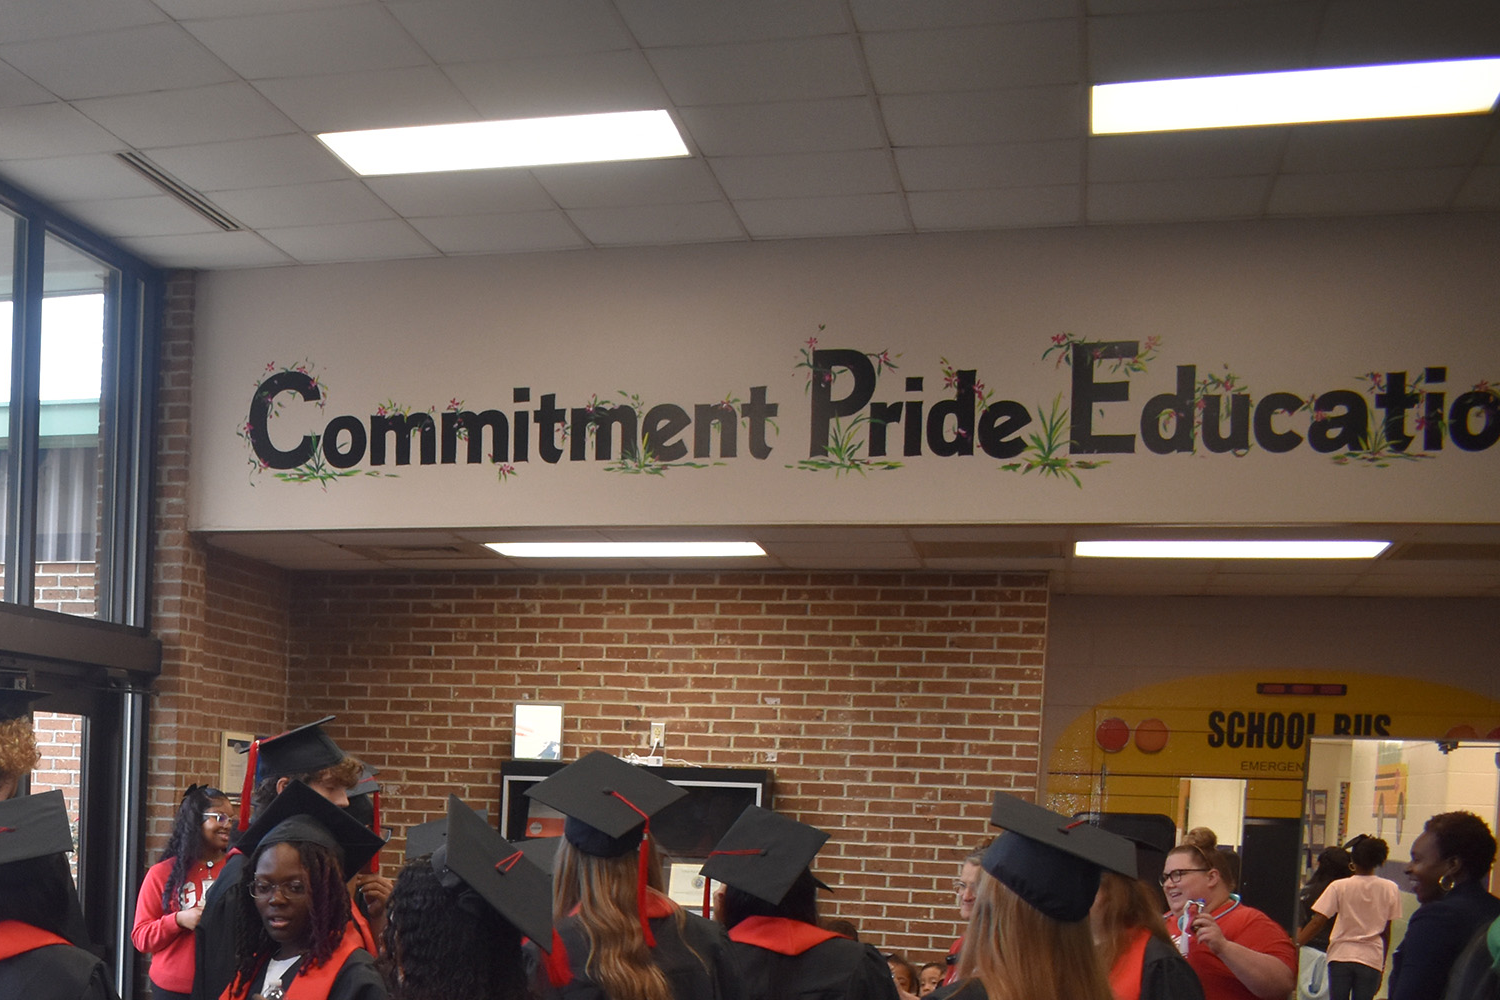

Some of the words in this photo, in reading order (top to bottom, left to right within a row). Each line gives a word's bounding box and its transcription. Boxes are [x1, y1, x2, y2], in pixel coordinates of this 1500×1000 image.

[248, 371, 779, 470] Commitment
[810, 348, 1032, 458] Pride
[1069, 340, 1500, 455] Educatio
